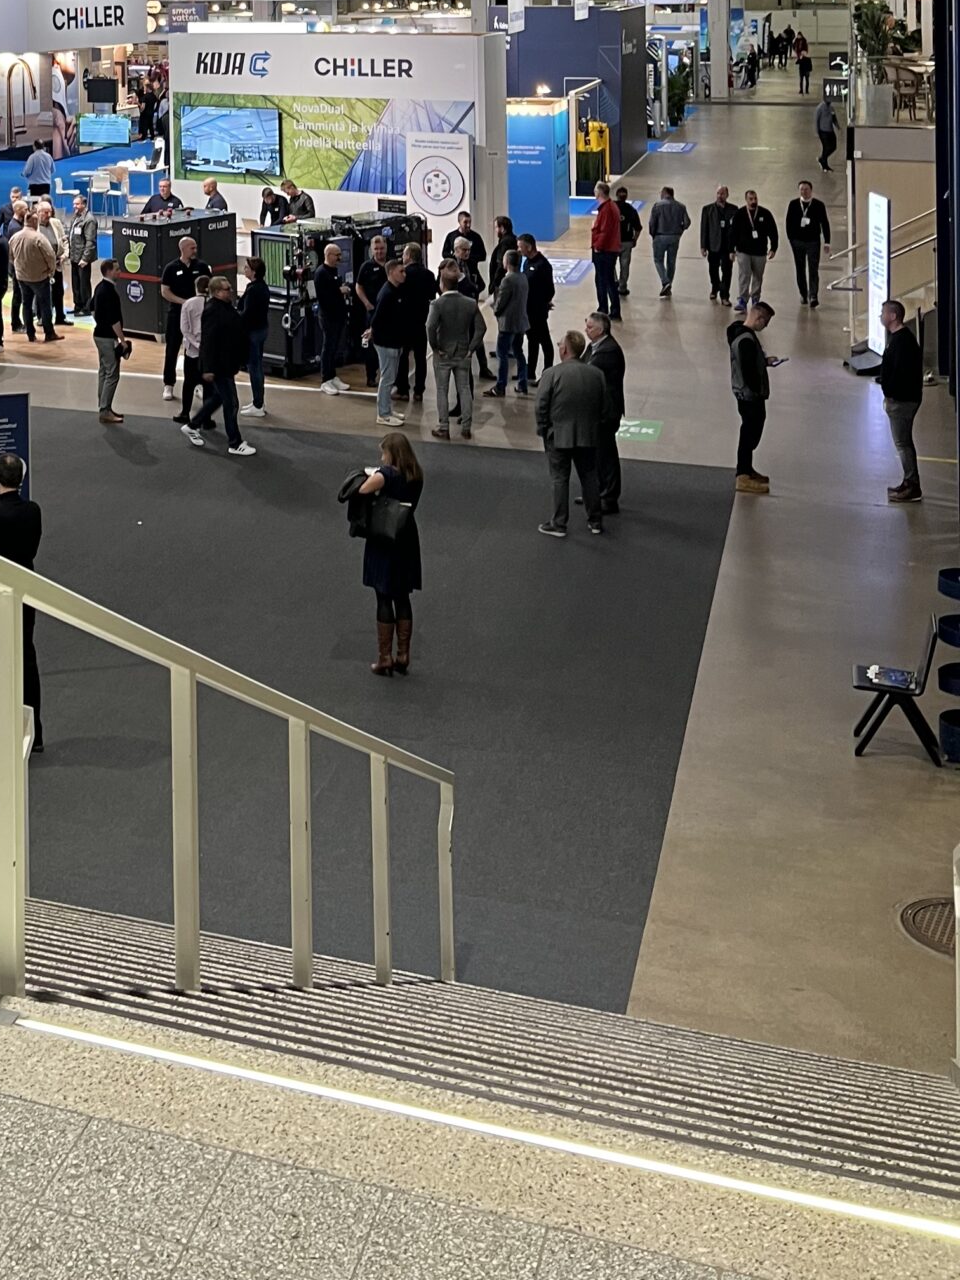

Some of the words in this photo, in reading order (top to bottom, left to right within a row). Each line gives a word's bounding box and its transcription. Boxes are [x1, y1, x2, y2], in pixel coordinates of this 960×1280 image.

[196, 52, 245, 75] KOJA
[293, 103, 344, 115] NovaDual
[348, 122, 358, 134] ja
